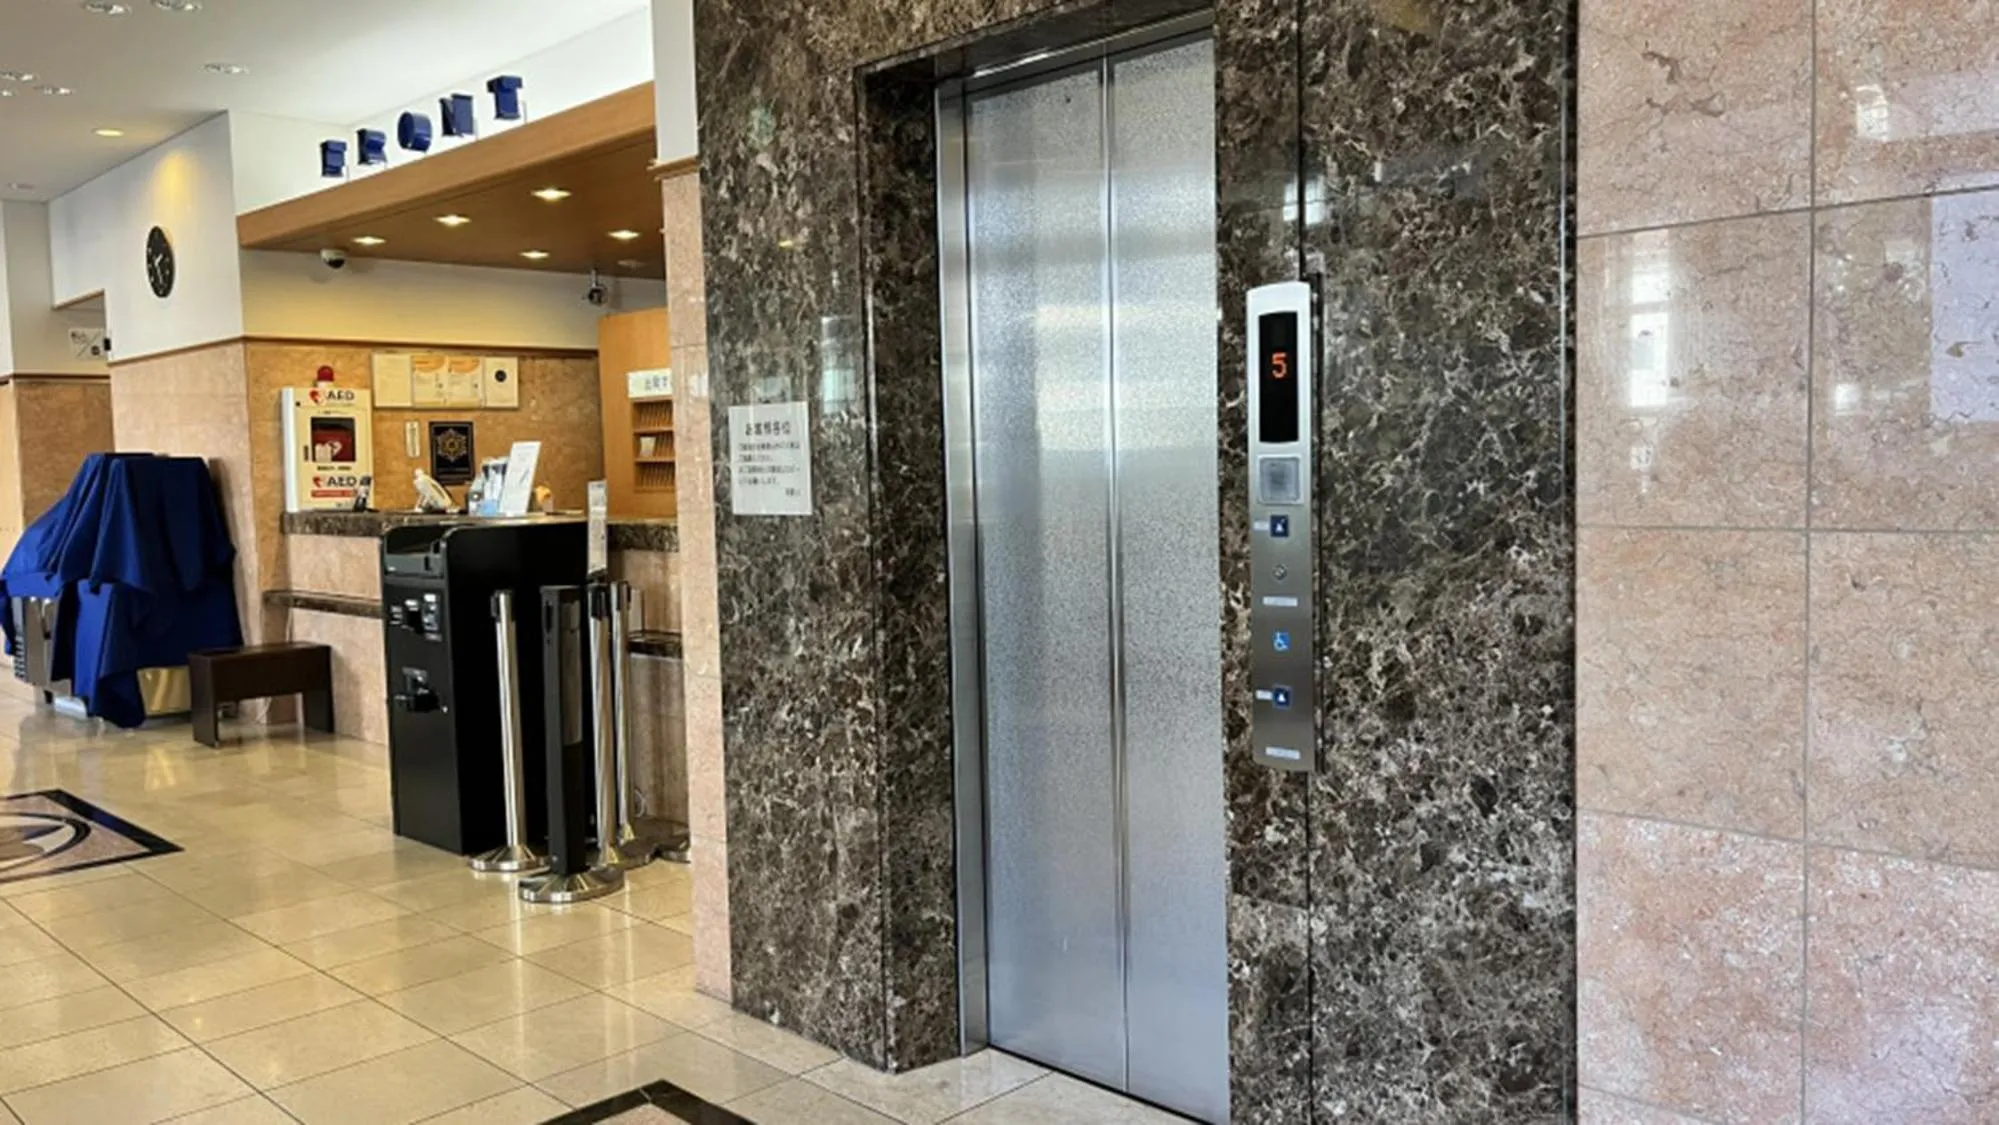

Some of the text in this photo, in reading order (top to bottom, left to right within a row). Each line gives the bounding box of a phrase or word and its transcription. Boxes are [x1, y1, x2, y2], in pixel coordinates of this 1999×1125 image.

[320, 75, 523, 177] FRONT
[1271, 352, 1287, 378] 5
[326, 389, 355, 401] AED
[327, 476, 357, 487] AED
